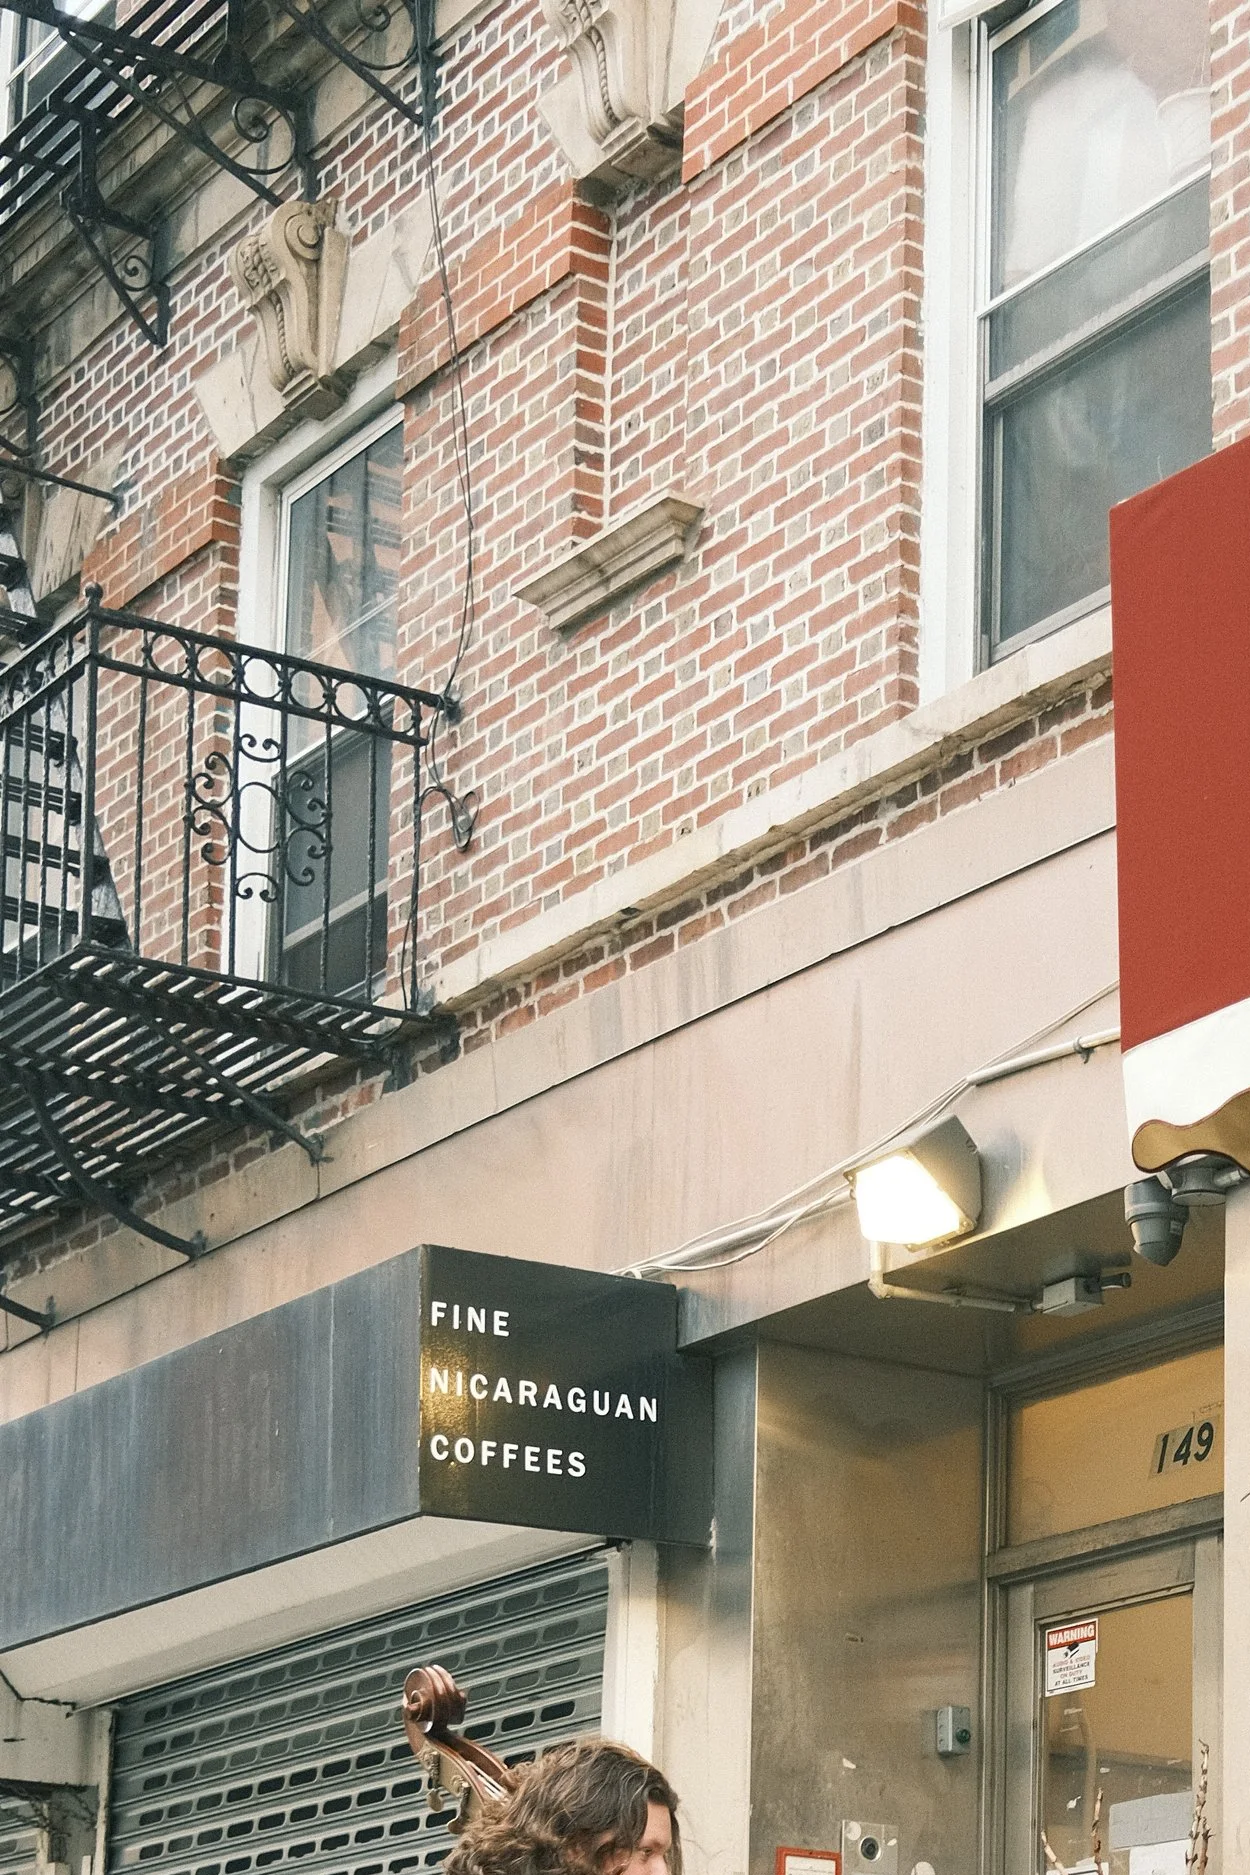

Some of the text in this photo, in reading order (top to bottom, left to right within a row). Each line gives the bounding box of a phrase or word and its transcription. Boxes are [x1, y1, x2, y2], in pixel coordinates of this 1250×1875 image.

[431, 1301, 510, 1337] FINE
[430, 1367, 658, 1422] NICARAGUAN
[430, 1434, 586, 1477] COFFEES
[1157, 1422, 1214, 1473] 149
[1048, 1625, 1095, 1646] WARNING
[1053, 1661, 1090, 1674] SURVEILLANCE
[1069, 1669, 1082, 1677] DUTY
[1073, 1674, 1089, 1683] TIMES
